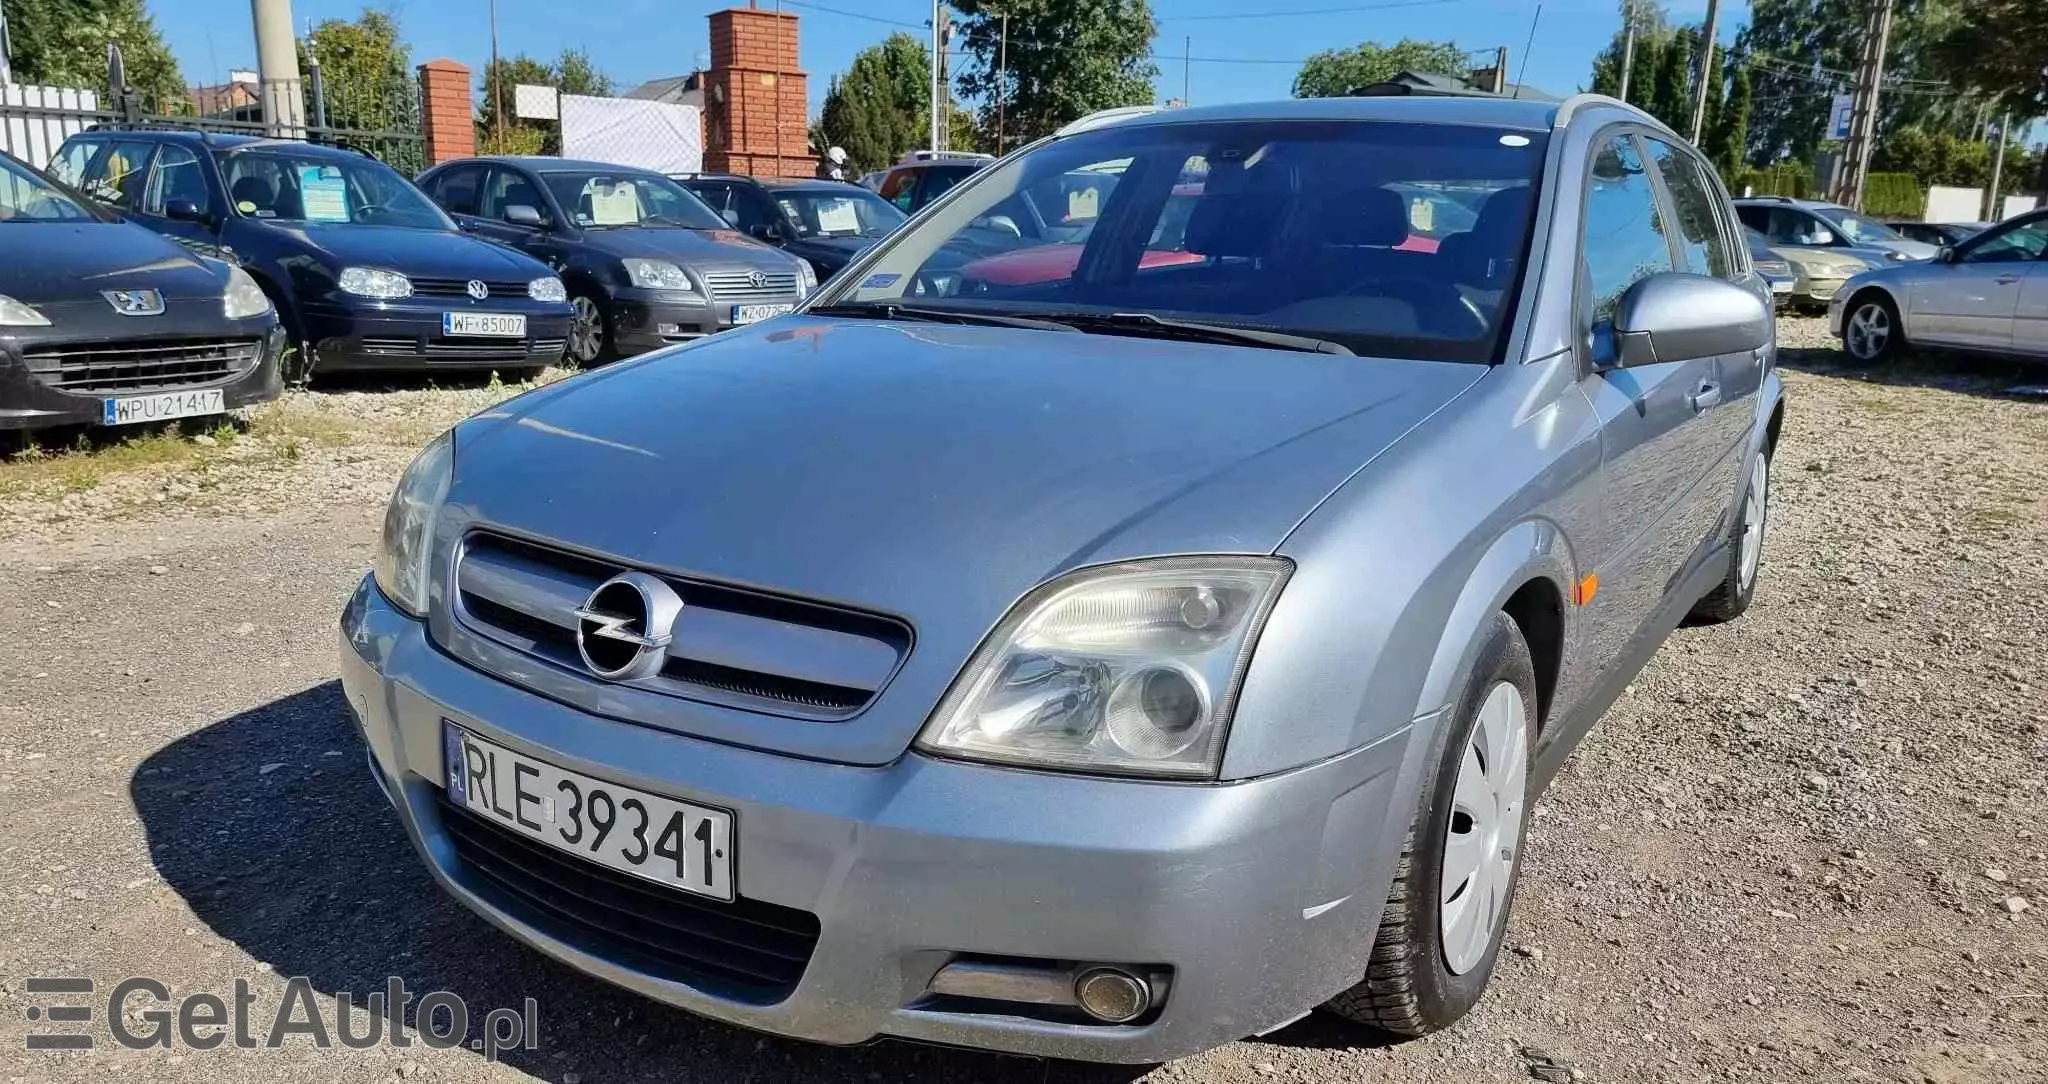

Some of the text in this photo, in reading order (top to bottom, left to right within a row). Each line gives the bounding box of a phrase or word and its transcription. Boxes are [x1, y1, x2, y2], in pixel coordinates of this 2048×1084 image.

[454, 315, 522, 334] WF 85007
[117, 391, 221, 421] WPU 21417
[450, 772, 465, 792] PL
[464, 742, 713, 887] RLE 39341
